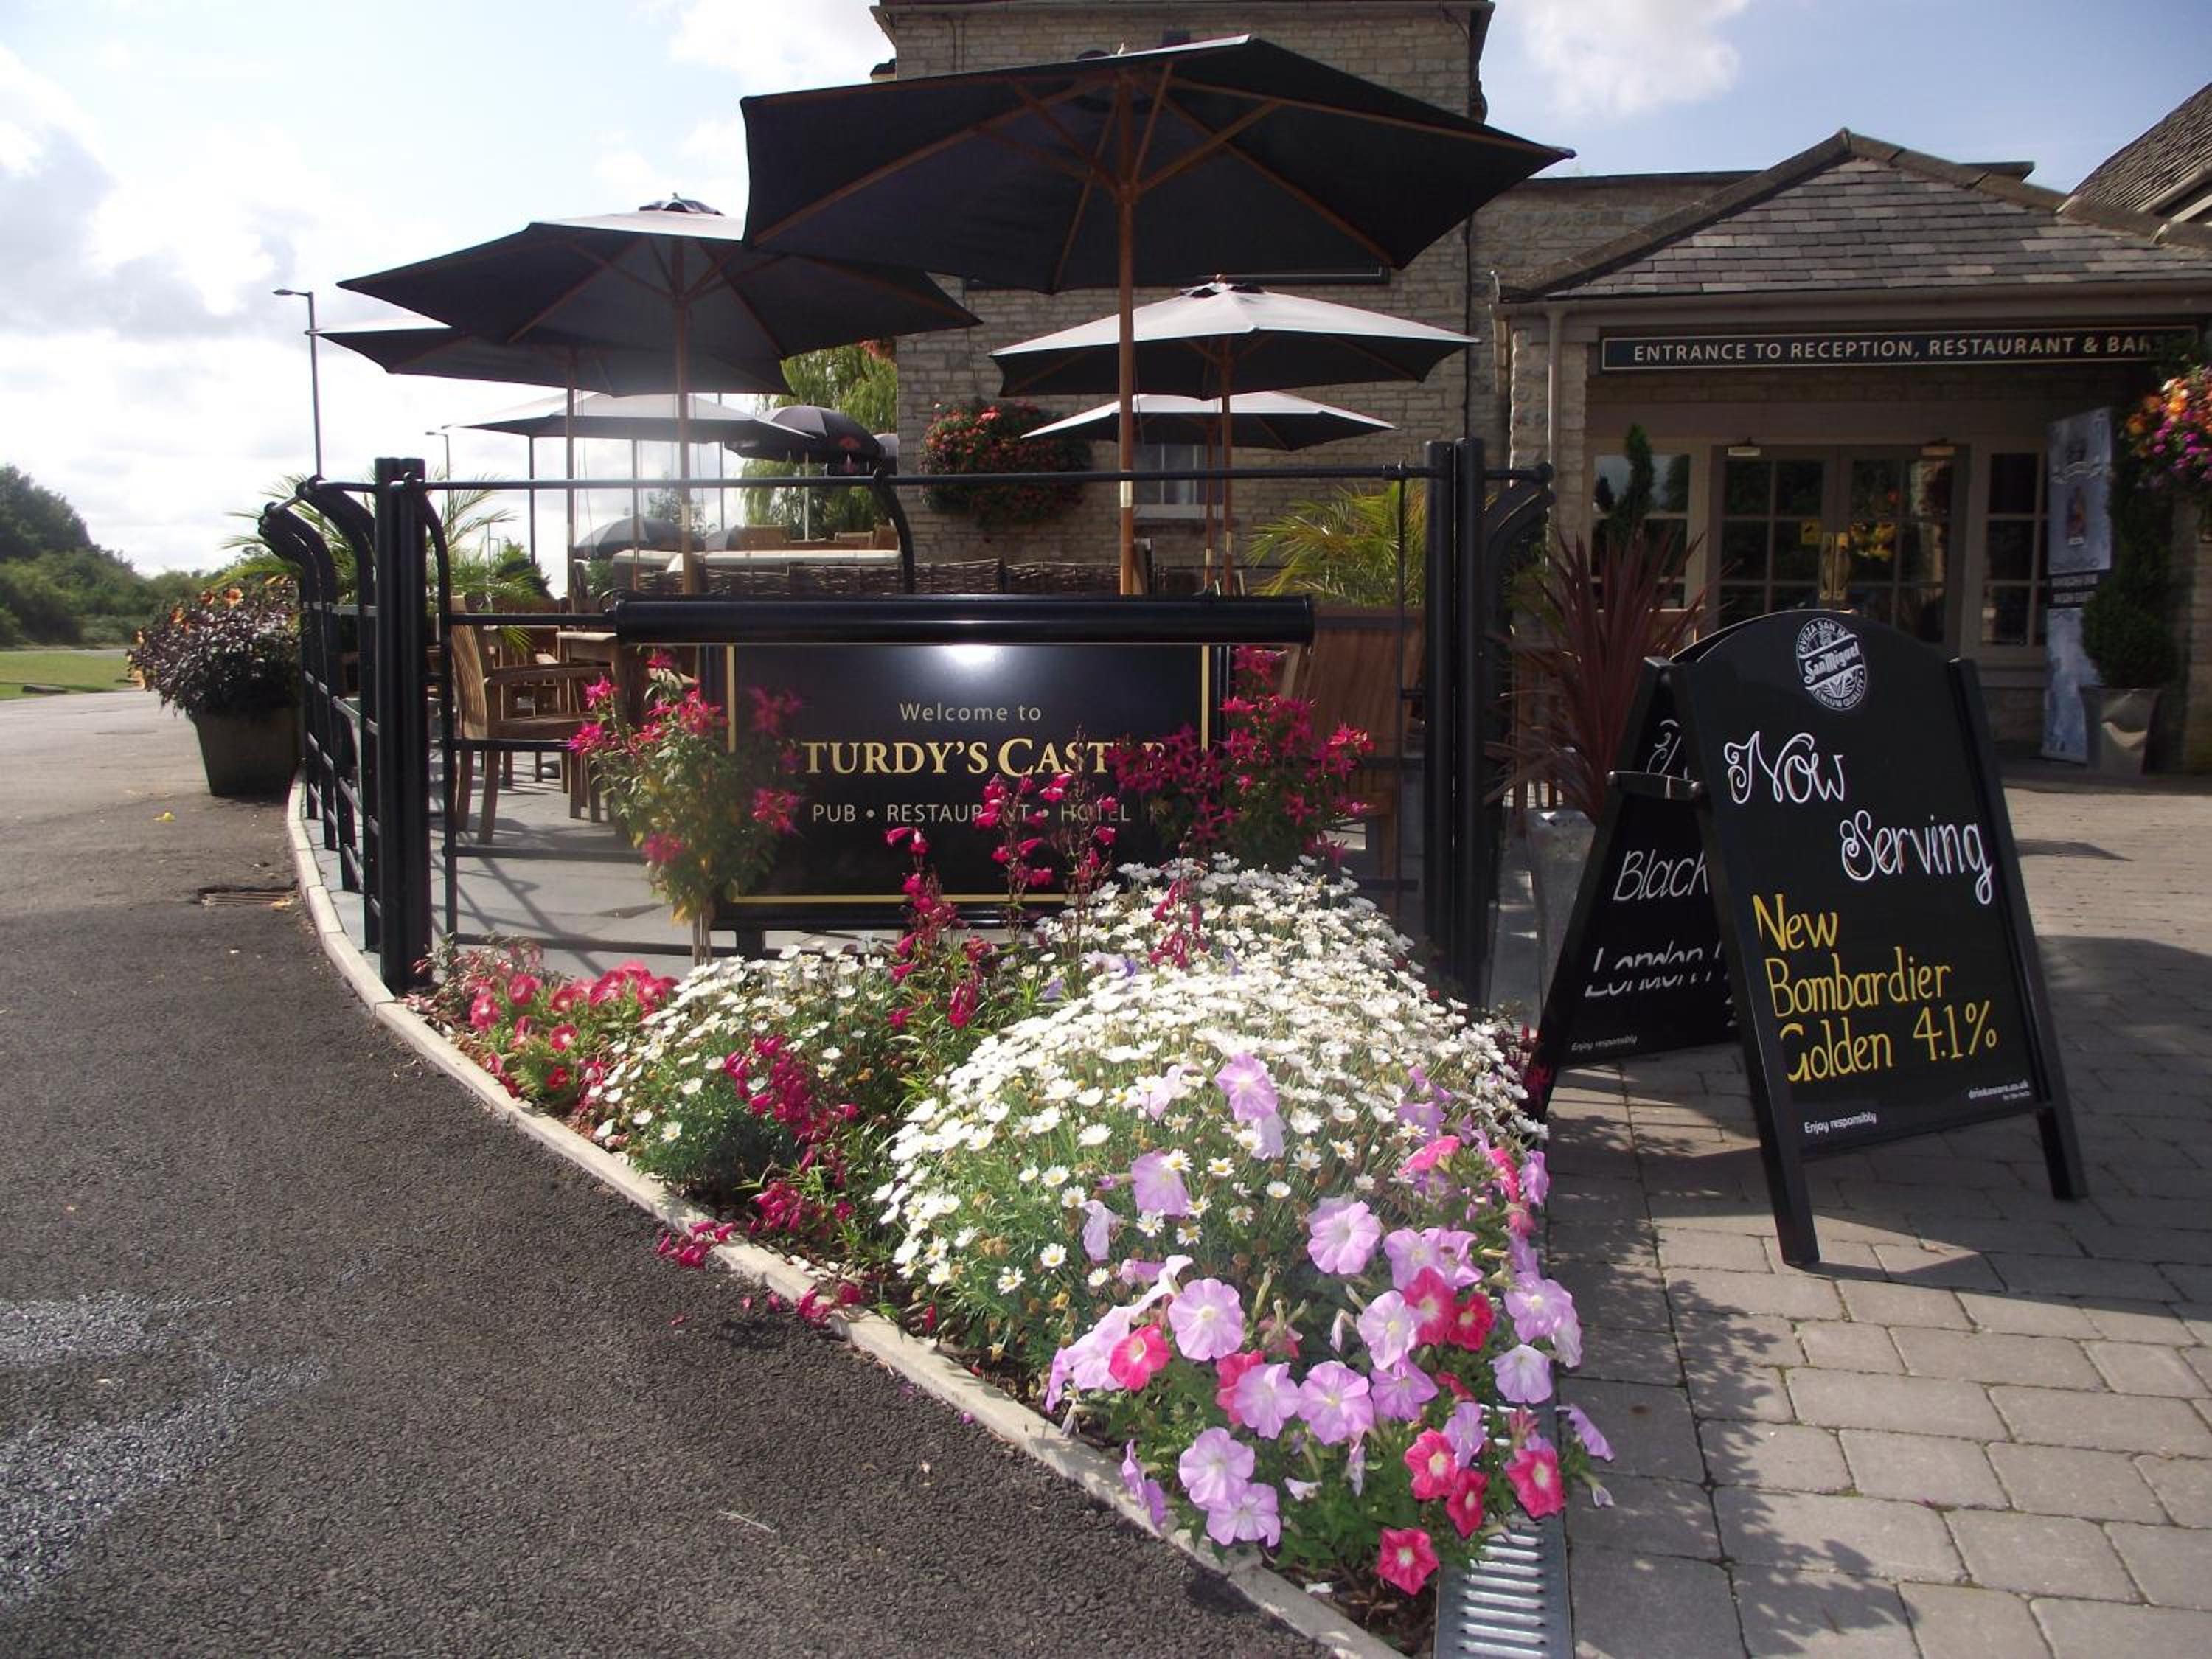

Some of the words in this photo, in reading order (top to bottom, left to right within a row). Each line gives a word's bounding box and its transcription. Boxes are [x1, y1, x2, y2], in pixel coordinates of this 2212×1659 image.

[1633, 343, 1747, 361] ENTRANCE
[1754, 343, 1782, 360] TO
[1929, 337, 2076, 355] RESTAURANT
[2083, 336, 2098, 354] &
[900, 702, 1008, 722] Welcome
[1018, 704, 1042, 722] to
[1724, 731, 1845, 804] Now
[813, 804, 856, 823] PUB
[1840, 810, 1993, 905] Serving
[1752, 893, 1839, 952] New
[1765, 946, 1952, 1018] Bombardier
[1779, 1017, 1894, 1082] Golden
[1912, 1000, 1997, 1062] 4.1%
[1804, 1121, 1829, 1135] Enjoy
[1829, 1110, 1877, 1129] responsibly
